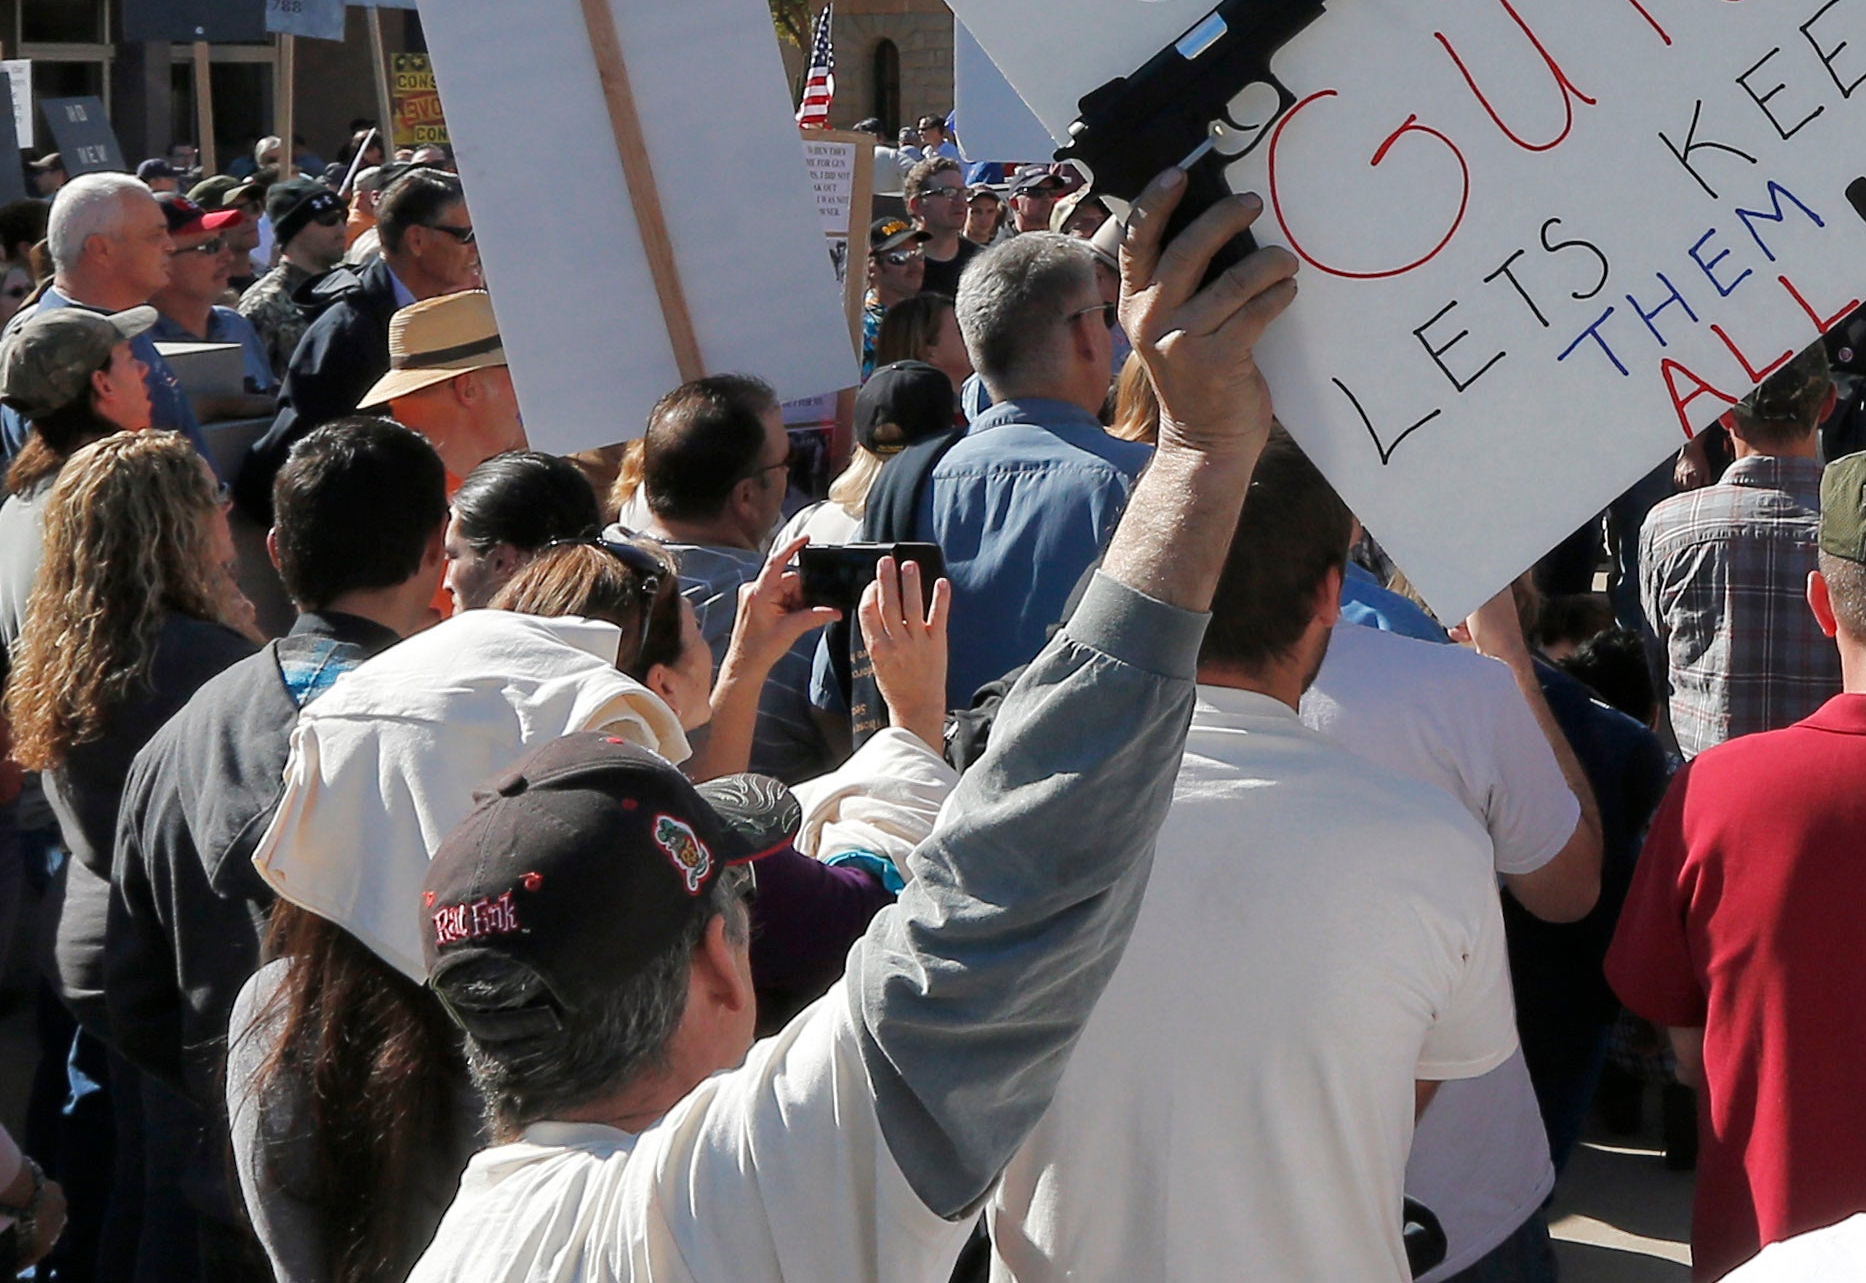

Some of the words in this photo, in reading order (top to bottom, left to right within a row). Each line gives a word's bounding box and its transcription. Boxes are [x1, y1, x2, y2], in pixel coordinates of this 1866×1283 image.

[1331, 217, 1609, 465] LETS
[1557, 180, 1825, 377] THEM
[431, 902, 469, 946] Rat
[470, 893, 519, 938] Fink
